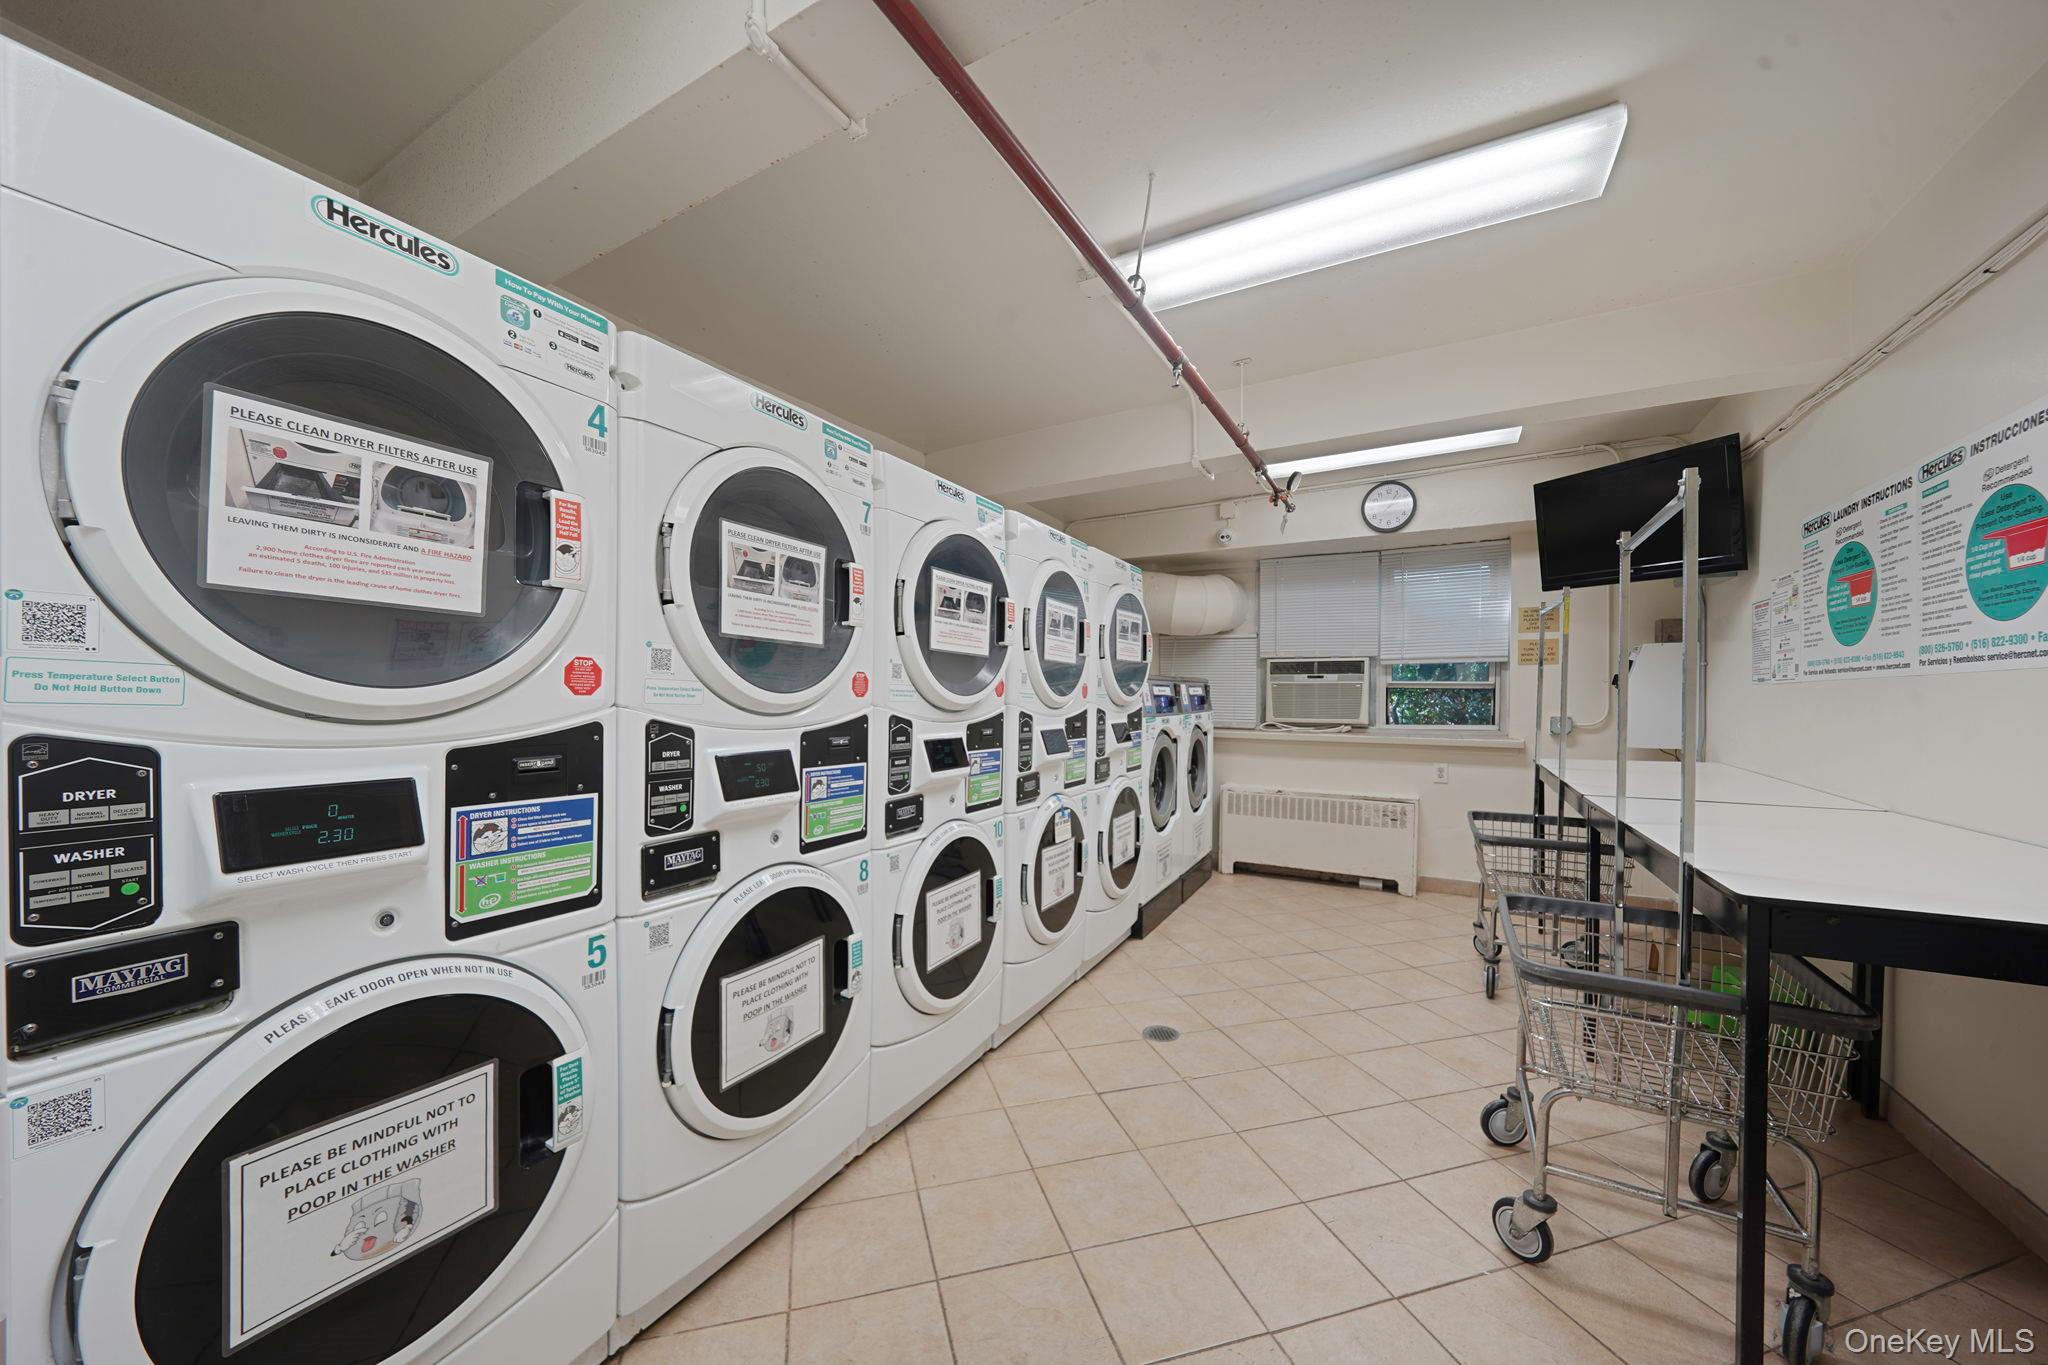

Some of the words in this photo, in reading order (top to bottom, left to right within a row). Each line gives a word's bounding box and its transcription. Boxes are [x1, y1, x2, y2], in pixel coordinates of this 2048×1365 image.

[326, 197, 451, 270] Hercules
[504, 278, 522, 290] How
[523, 286, 532, 296] To
[533, 291, 546, 303] Pay
[546, 297, 563, 309] With
[563, 305, 580, 318] Your
[580, 313, 601, 327] Phone
[565, 363, 595, 380] Hercules
[587, 404, 608, 438] 4
[755, 393, 805, 427] Hercules
[230, 406, 282, 427] PLEASE
[286, 420, 330, 438] CLEAN
[334, 432, 375, 450] DRYER
[378, 443, 420, 461] FILTERS
[422, 455, 456, 471] AFTER
[458, 464, 478, 476] USE
[1921, 450, 1963, 480] Hercules
[1995, 454, 2030, 475] Detergent
[1981, 466, 2033, 492] Recommended
[936, 480, 965, 501] Hercules
[862, 501, 871, 524] 7
[1803, 514, 1830, 536] Hercules
[1833, 500, 1860, 522] LAUNDRY
[1860, 476, 1913, 510] INSTRUCTIONS
[1834, 529, 1864, 545] Recommended
[1842, 520, 1862, 534] Detergent
[227, 516, 269, 528] LEAVING
[271, 522, 298, 533] THEM
[301, 528, 327, 538] DIRTY
[338, 534, 401, 550] INCONSIDERATE
[402, 544, 419, 552] AND
[443, 551, 472, 561] HAZARD
[727, 528, 746, 539] PLEASE
[747, 534, 764, 543] CLEAN
[765, 539, 781, 547] DRYER
[781, 542, 799, 552] FILTERS
[799, 547, 813, 555] AFTER
[304, 544, 337, 554] According
[373, 554, 416, 566] Administration
[238, 566, 264, 575] Failure
[274, 570, 293, 578] clean
[294, 572, 307, 580] the
[307, 574, 326, 583] dryer
[346, 580, 369, 588] leading
[1927, 656, 1948, 666] Servicios
[1986, 648, 2048, 662] service@hercnet.co
[11, 670, 44, 679] Press
[47, 671, 113, 682] Temperature
[115, 674, 147, 683] Select
[150, 675, 181, 684] Button
[34, 682, 48, 691] Do
[52, 683, 70, 692] Not
[73, 684, 97, 692] Hold
[100, 685, 133, 693] Button
[136, 686, 162, 694] Down
[661, 750, 681, 759] DRYER
[62, 789, 117, 803] DRYER
[658, 783, 683, 792] WASHER
[469, 809, 492, 820] DRYER
[493, 805, 540, 818] INSTRUCTIONS
[317, 828, 354, 844] 2.30
[994, 820, 1003, 839] 10
[53, 847, 125, 864] WASHER
[237, 871, 273, 883] SELECT
[276, 866, 304, 877] WASH
[306, 862, 334, 873] CYCLE
[336, 859, 359, 868] THEN
[360, 854, 388, 865] PRESS
[388, 850, 413, 861] START
[469, 859, 499, 870] WASHER
[500, 851, 546, 865] INSTRUCTIONS
[666, 850, 702, 866] MAYTAG
[113, 865, 144, 874] DELICATES
[859, 859, 869, 881] 8
[587, 934, 608, 969] 5
[79, 957, 183, 993] MAYTAG
[96, 975, 167, 995] COMMERCIAL
[732, 983, 757, 999] PLEASE
[758, 979, 767, 988] BE
[767, 967, 795, 984] MINDFUL
[795, 961, 807, 970] NOT
[807, 955, 816, 965] TO
[741, 994, 762, 1007] PLACE
[763, 979, 794, 998] CLOTHING
[794, 970, 809, 982] WITH
[263, 1006, 317, 1044] PLEASE
[359, 975, 396, 996] DOOR
[397, 967, 428, 982] OPEN
[430, 964, 462, 976] WHEN
[464, 965, 484, 975] NOT
[485, 966, 495, 976] IN
[496, 968, 513, 979] USE
[743, 1006, 763, 1020] POOP
[763, 1002, 771, 1012] IN
[772, 996, 784, 1006] THE
[784, 983, 808, 1001] WASHER
[259, 1153, 322, 1188] PLEASE
[327, 1143, 347, 1160] BE
[352, 1113, 423, 1151] MINDFUL
[426, 1100, 455, 1121] NOT
[457, 1092, 476, 1108] TO
[284, 1168, 336, 1199] PLACE
[340, 1134, 418, 1175] CLOTHING
[422, 1117, 459, 1141] WITH
[288, 1190, 337, 1221] POOP
[341, 1181, 358, 1197] IN
[363, 1165, 392, 1187] THE
[396, 1138, 456, 1172] WASHER
